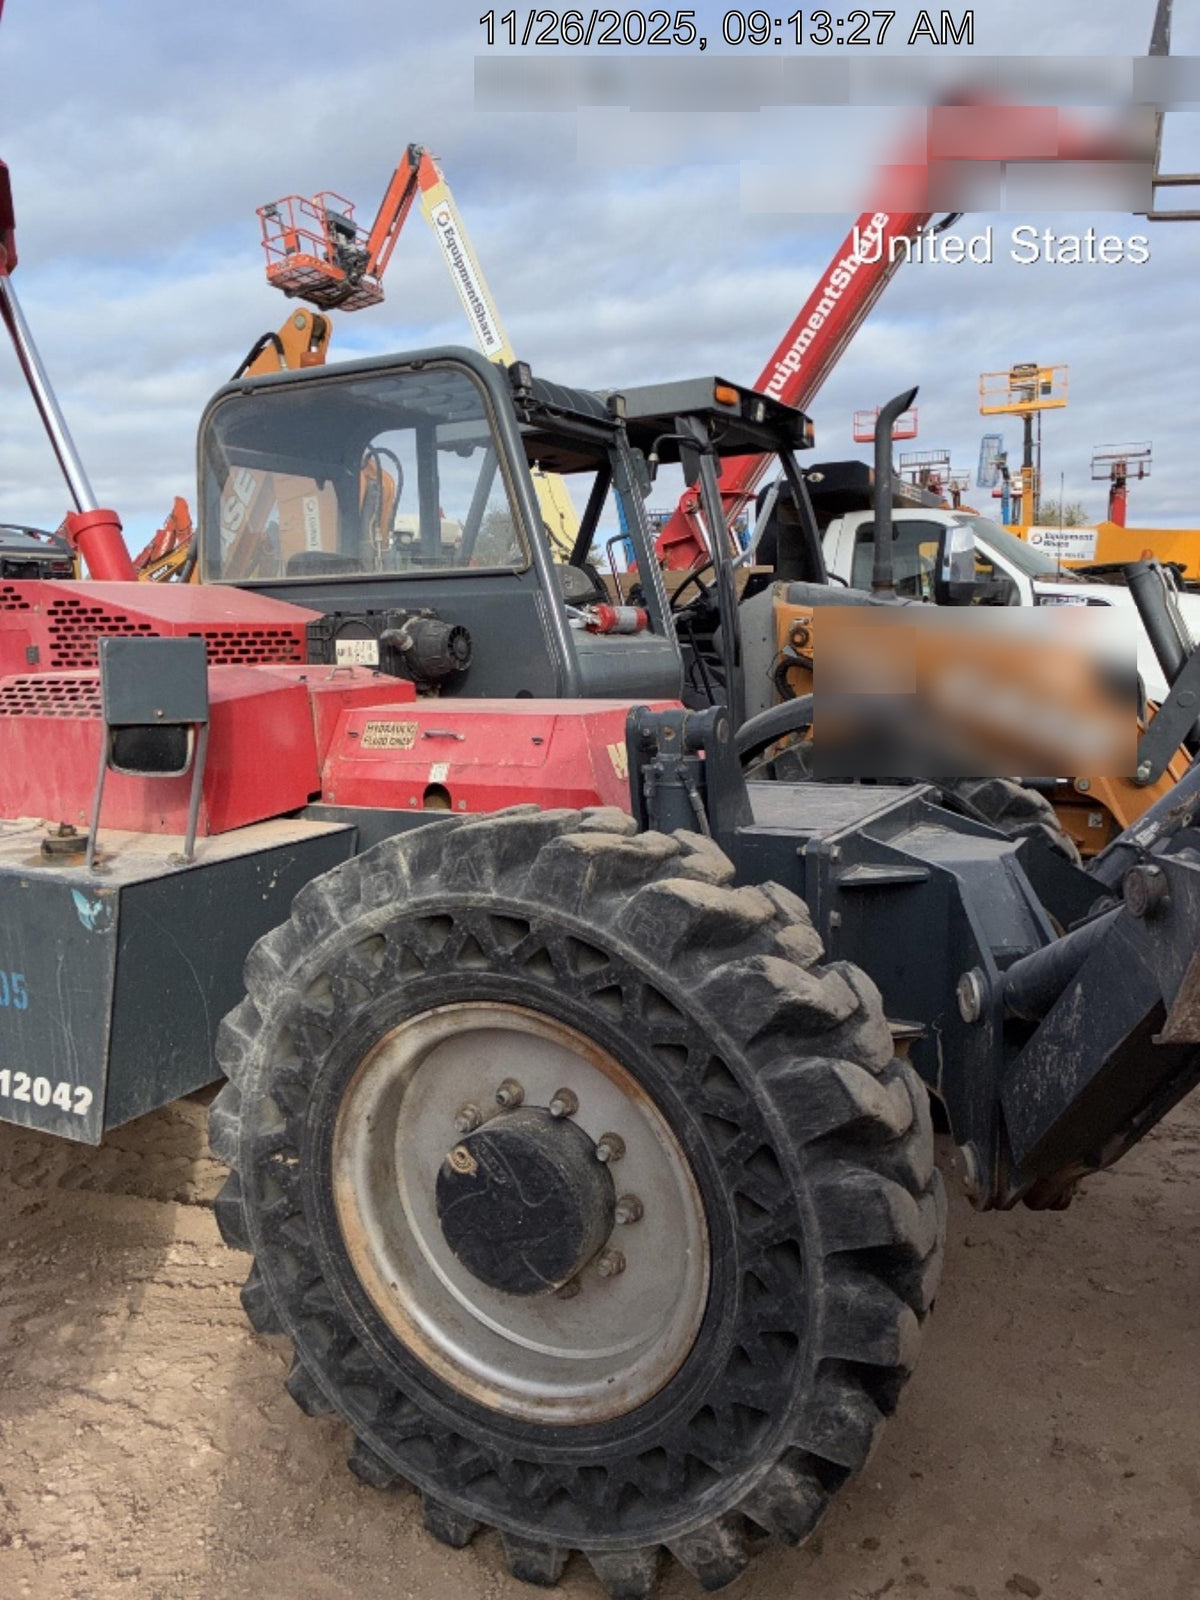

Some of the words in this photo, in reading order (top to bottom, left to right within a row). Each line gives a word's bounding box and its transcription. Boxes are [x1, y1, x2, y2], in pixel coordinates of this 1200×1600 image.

[443, 228, 495, 346] EquipmentShare
[763, 212, 890, 402] uipmentShare
[0, 1068, 93, 1116] 12042
